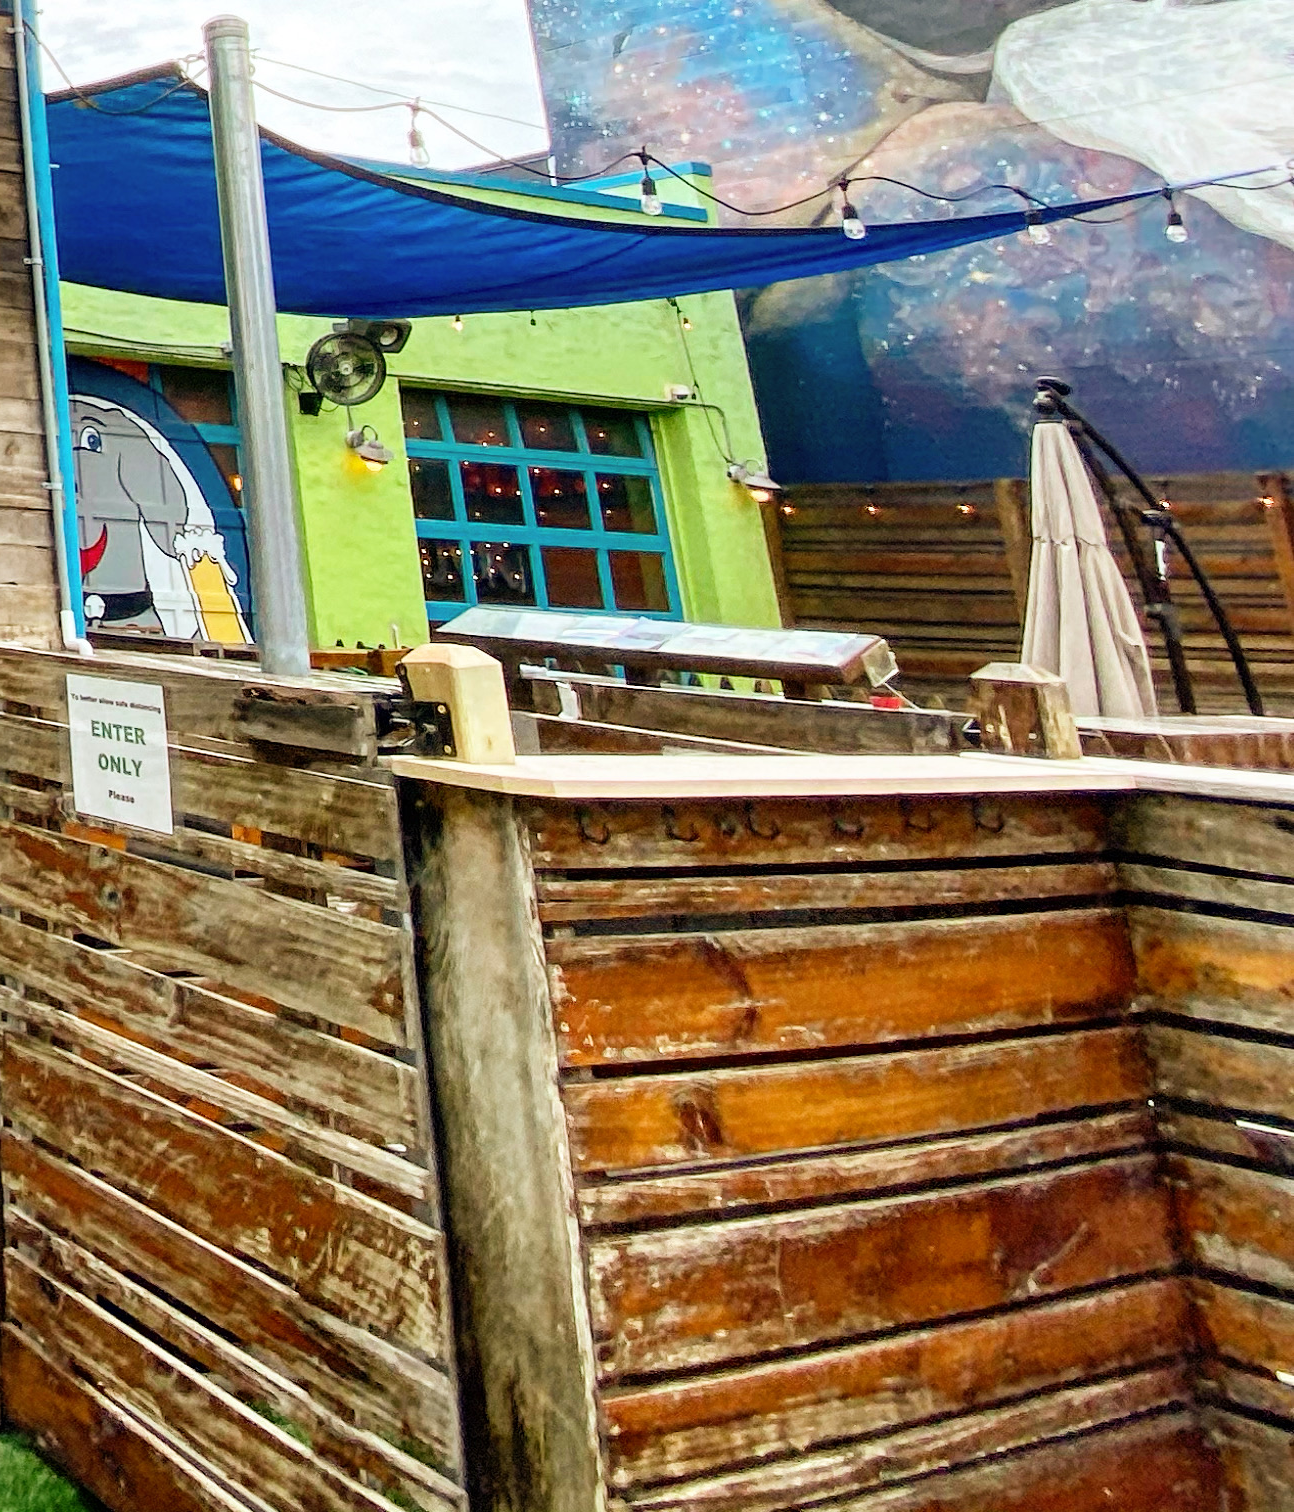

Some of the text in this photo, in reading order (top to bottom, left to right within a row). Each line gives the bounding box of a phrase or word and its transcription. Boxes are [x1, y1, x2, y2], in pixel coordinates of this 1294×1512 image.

[91, 719, 146, 745] ENTER
[98, 753, 143, 777] ONLY
[108, 789, 135, 804] Please
